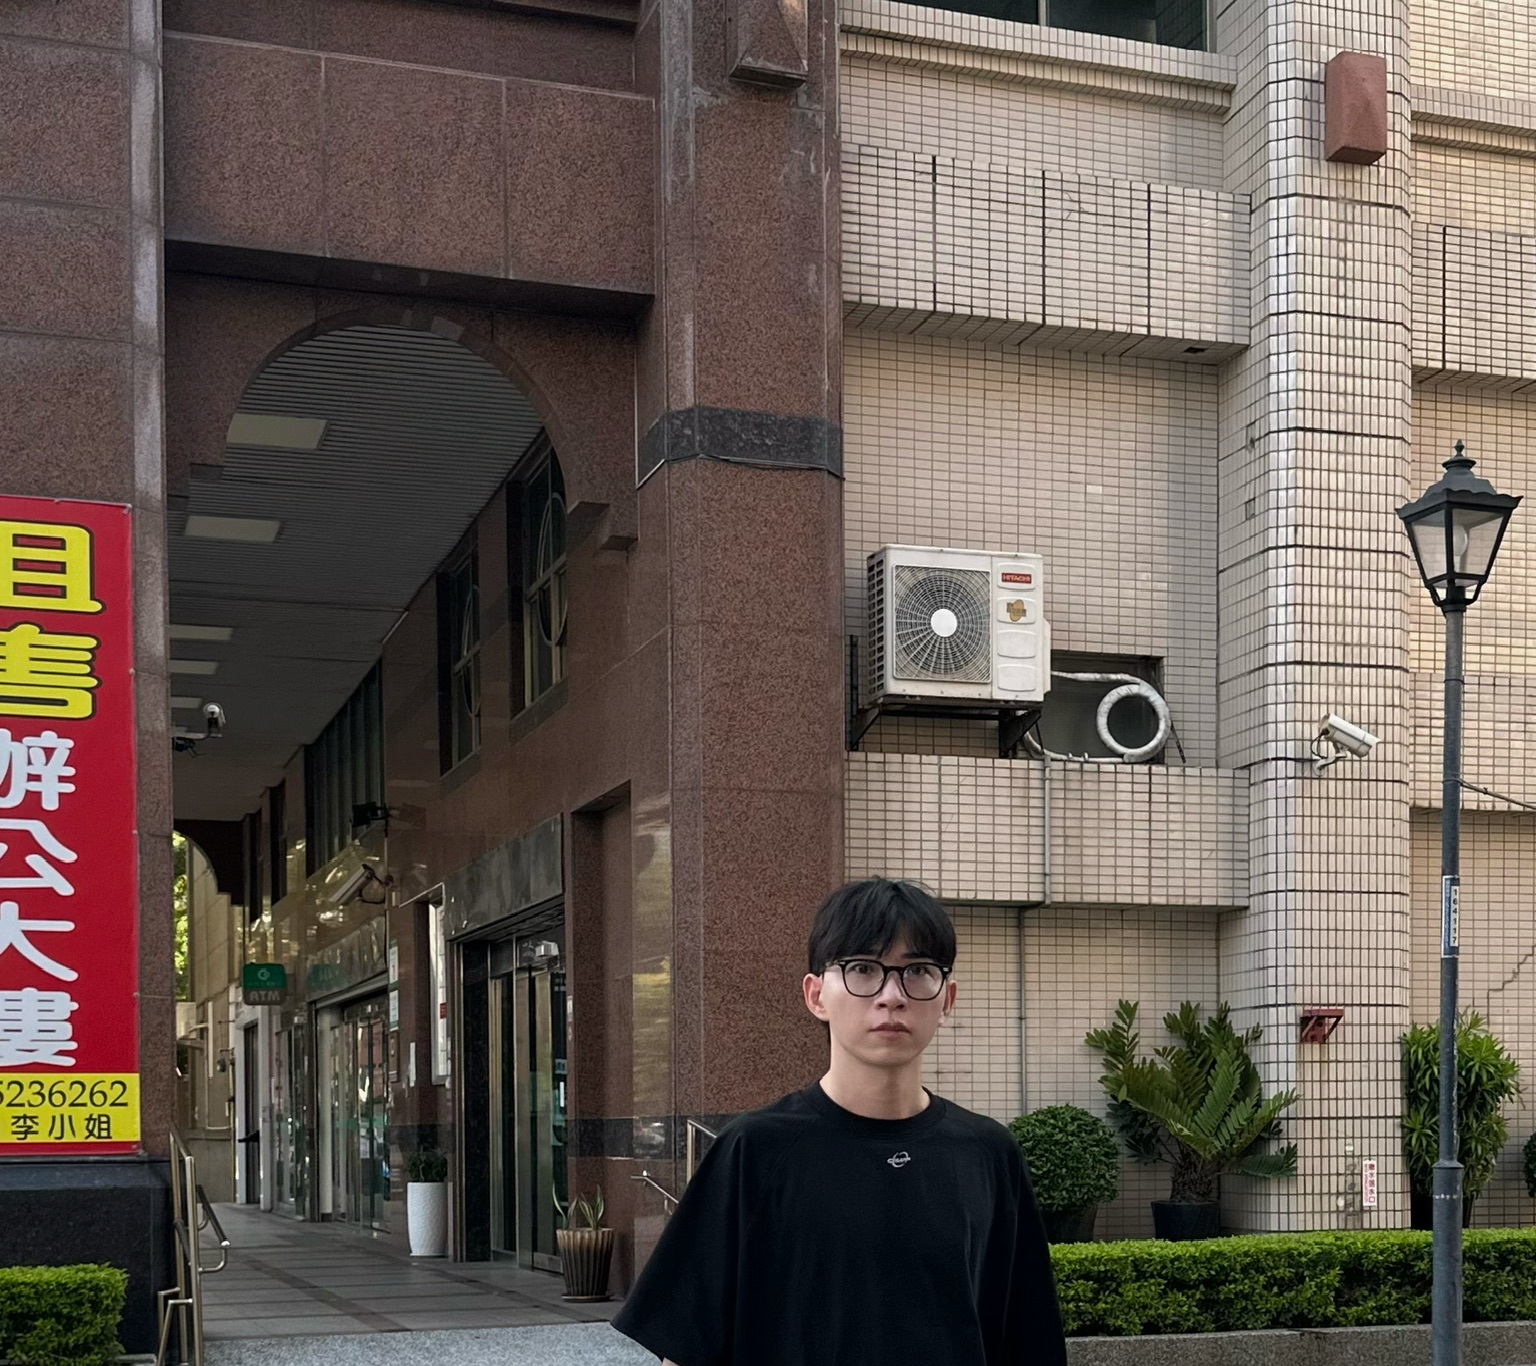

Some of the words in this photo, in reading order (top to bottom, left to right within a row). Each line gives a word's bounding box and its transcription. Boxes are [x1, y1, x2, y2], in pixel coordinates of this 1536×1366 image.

[1002, 574, 1031, 583] HITACHI
[250, 991, 280, 1001] ATM
[0, 1080, 128, 1108] 236262
[11, 1113, 112, 1140] 李小姐
